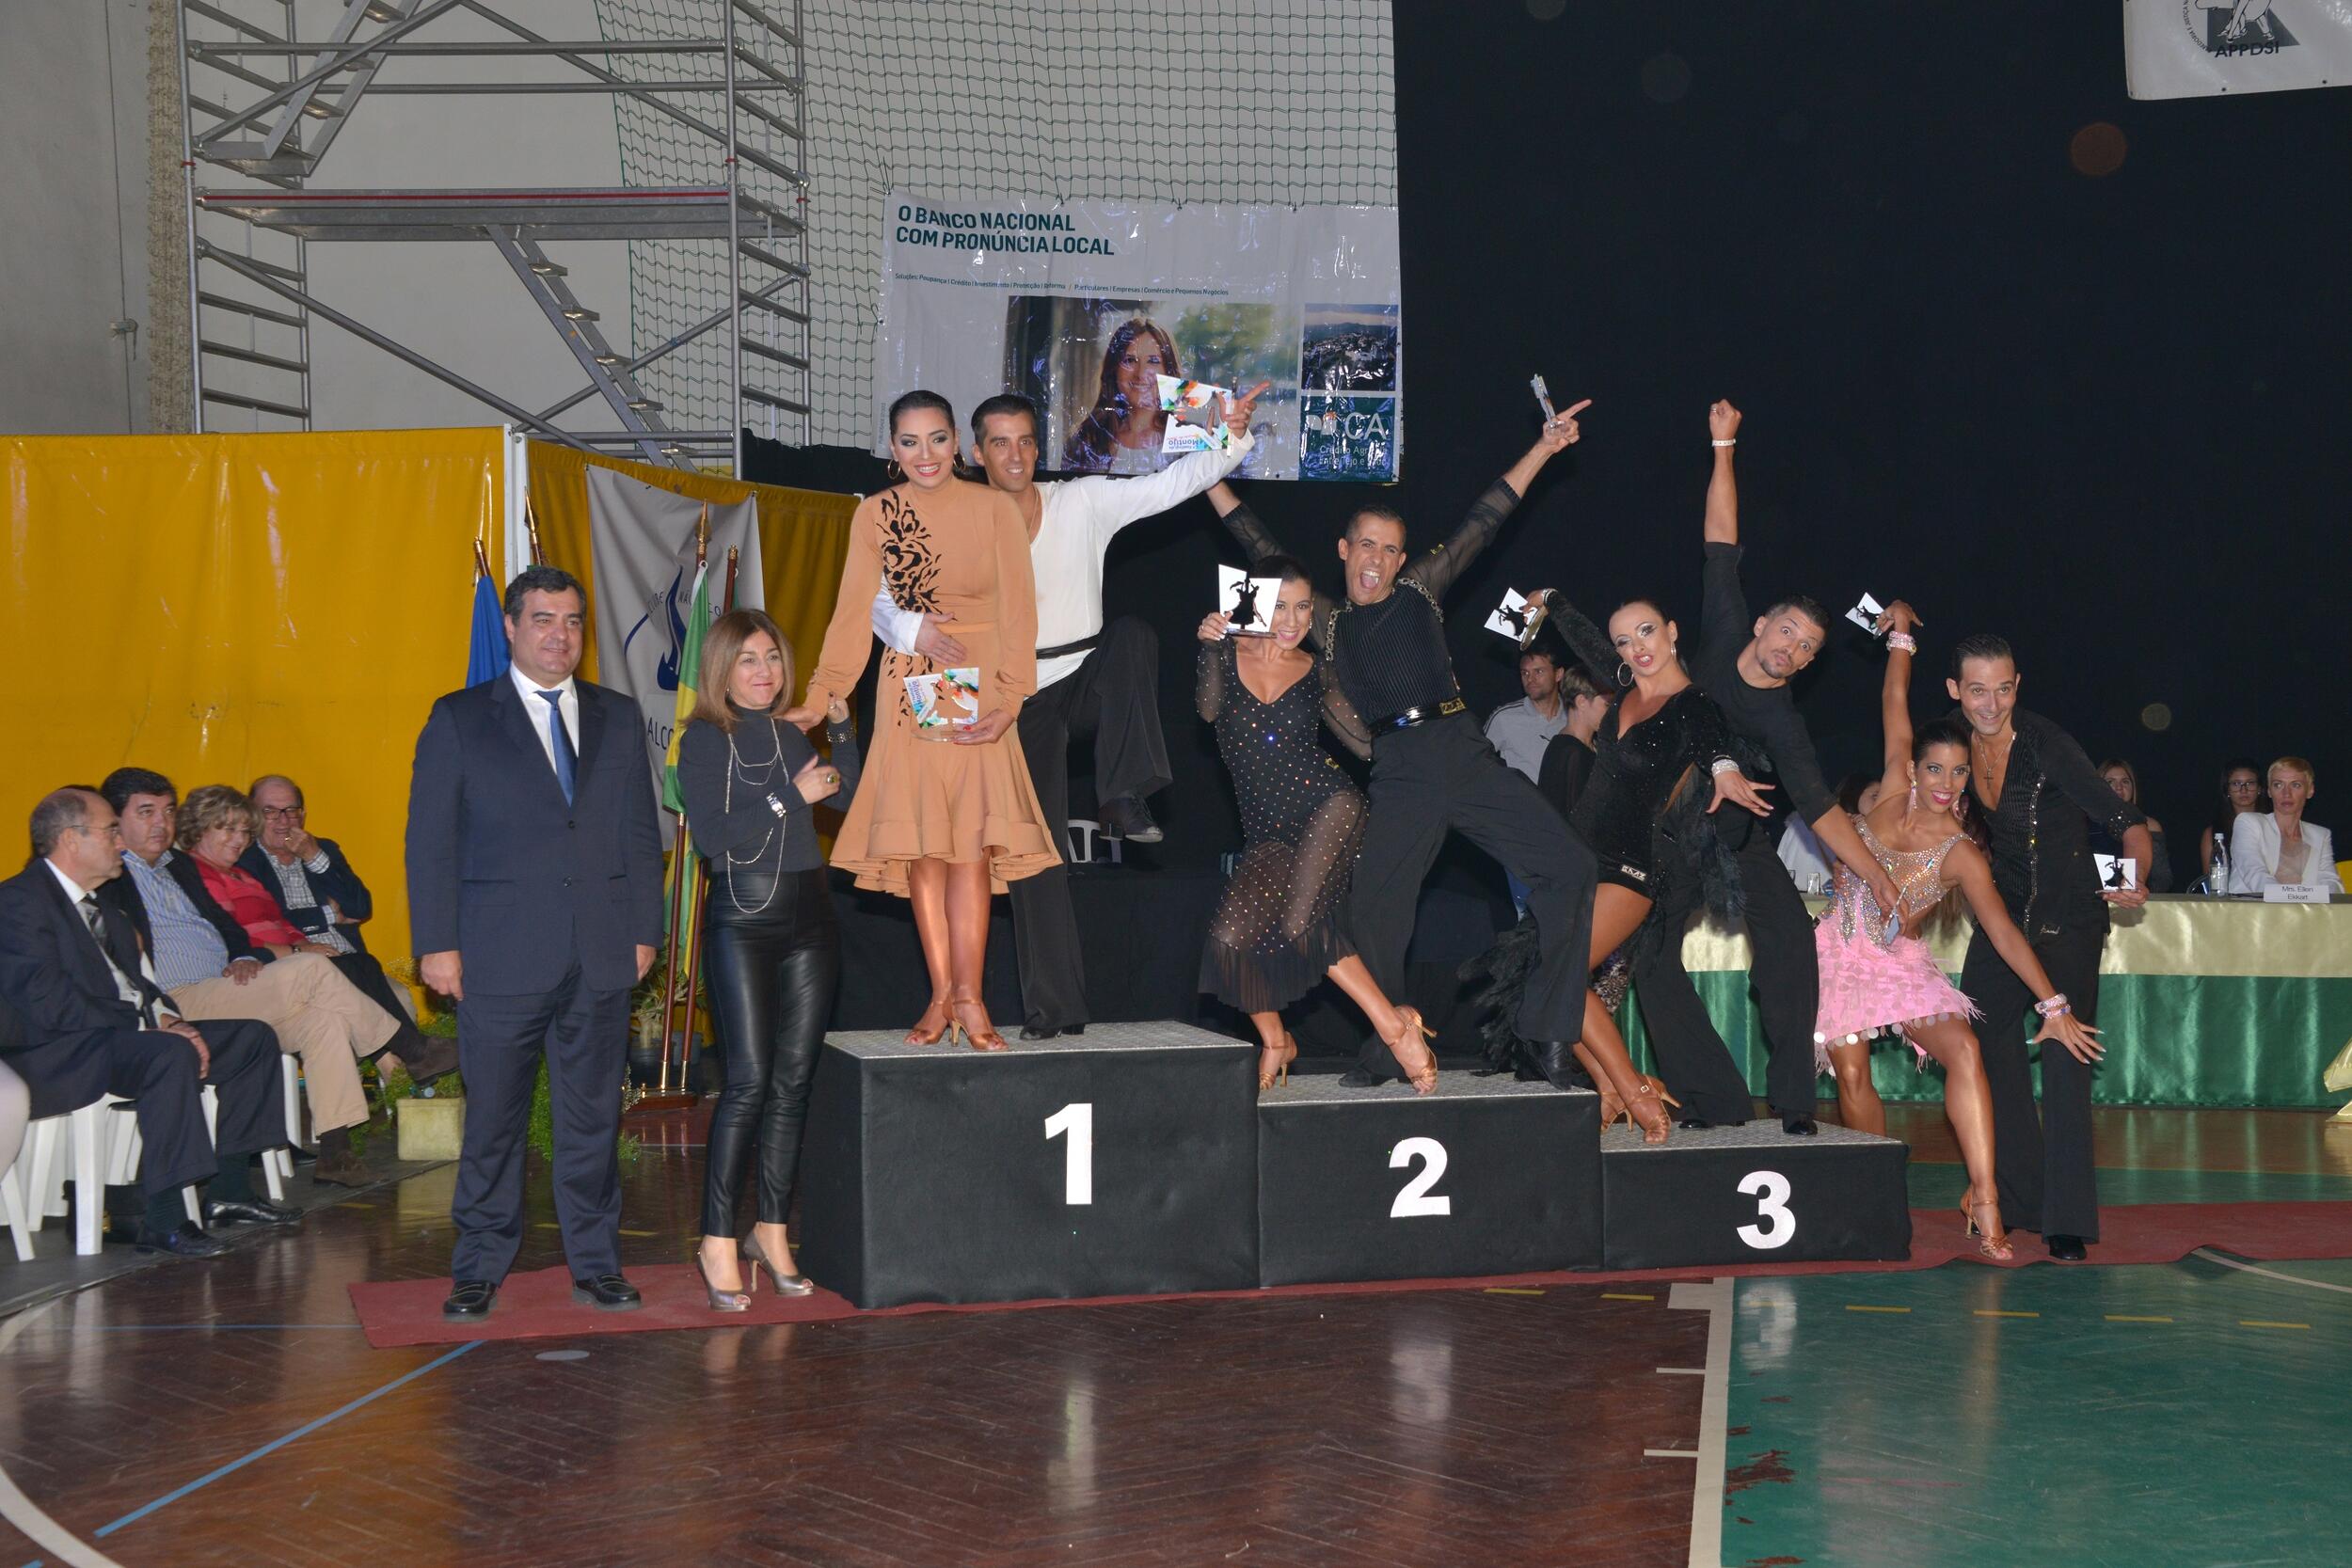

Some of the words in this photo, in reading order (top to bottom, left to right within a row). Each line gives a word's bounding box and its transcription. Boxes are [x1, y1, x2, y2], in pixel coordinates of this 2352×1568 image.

[2214, 40, 2280, 57] APPDSI
[898, 205, 912, 222] O
[915, 206, 977, 229] BANCO
[980, 212, 1076, 231] NACIONAL
[897, 226, 938, 247] COM
[942, 230, 1049, 253] PRONÚNCIA
[1052, 235, 1115, 256] LOCAL
[919, 273, 946, 284] Poupança
[950, 277, 972, 286] Crédito
[1112, 285, 1140, 293] Empresas
[1143, 286, 1171, 294] Comércio
[1344, 412, 1388, 440] CA
[1044, 1102, 1092, 1205] 1
[1389, 1136, 1451, 1218] 2
[1736, 1170, 1796, 1249] 3
